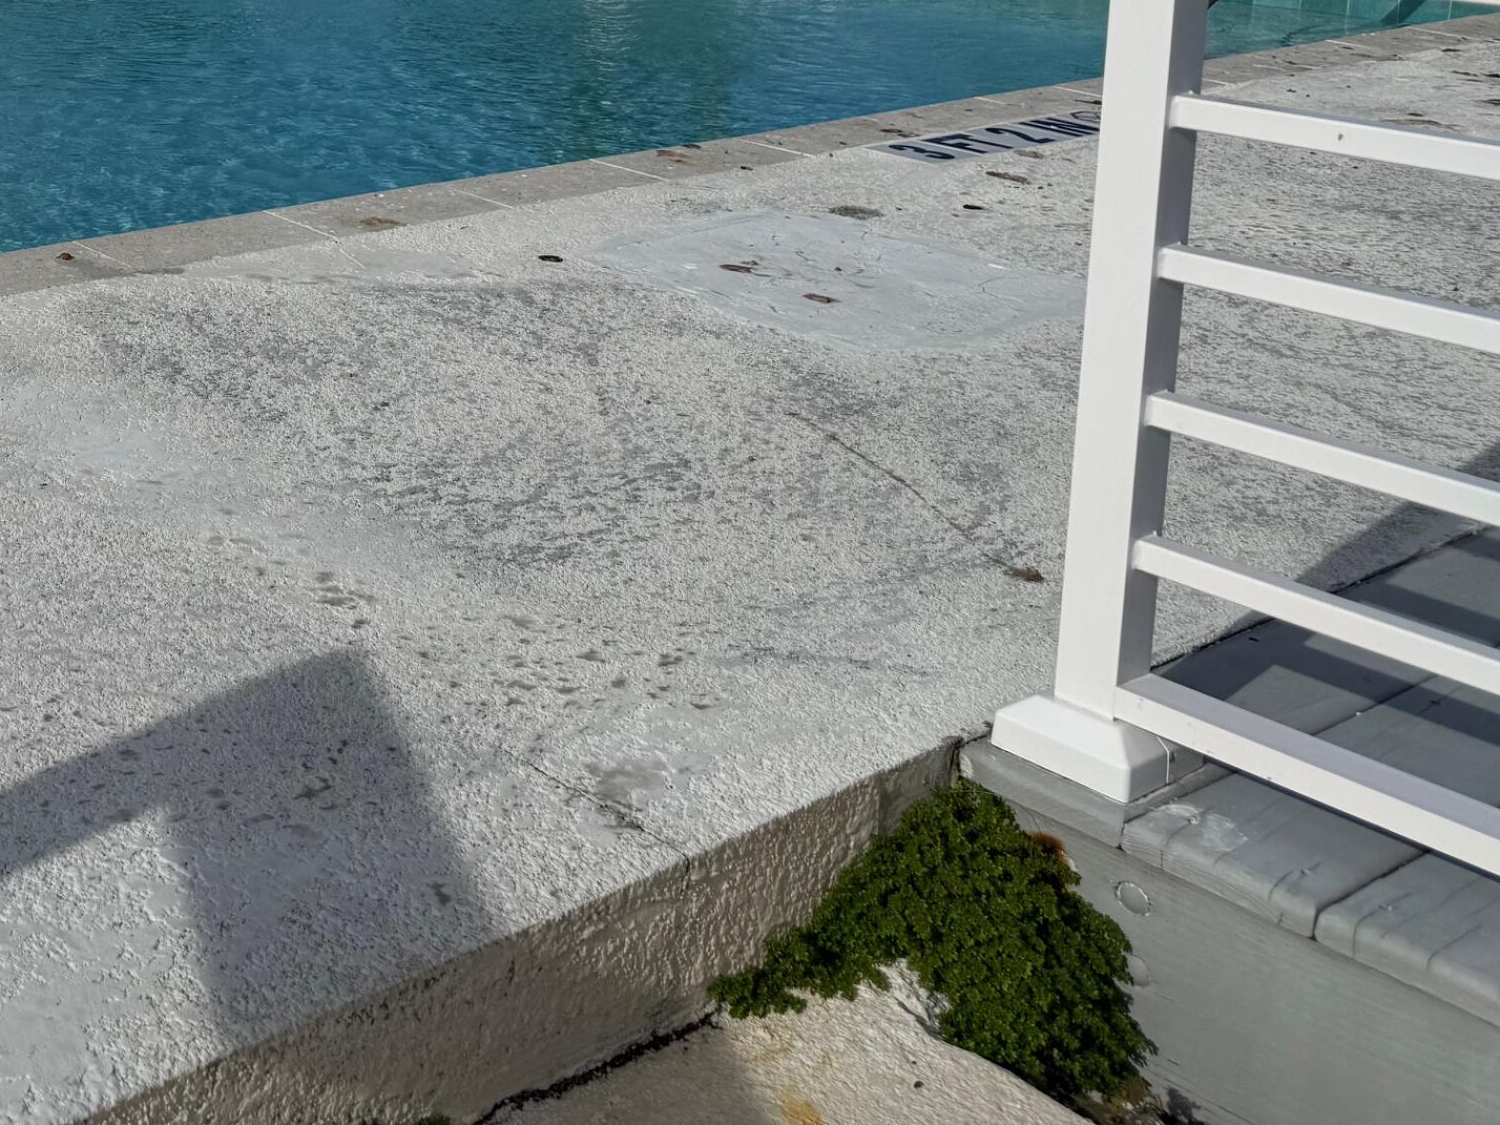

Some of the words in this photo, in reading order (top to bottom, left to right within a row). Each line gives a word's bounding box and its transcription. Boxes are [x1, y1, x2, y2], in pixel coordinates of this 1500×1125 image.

[984, 127, 1057, 144] 2
[1018, 117, 1100, 138] IN
[888, 144, 956, 160] 3
[919, 133, 1015, 154] FT
